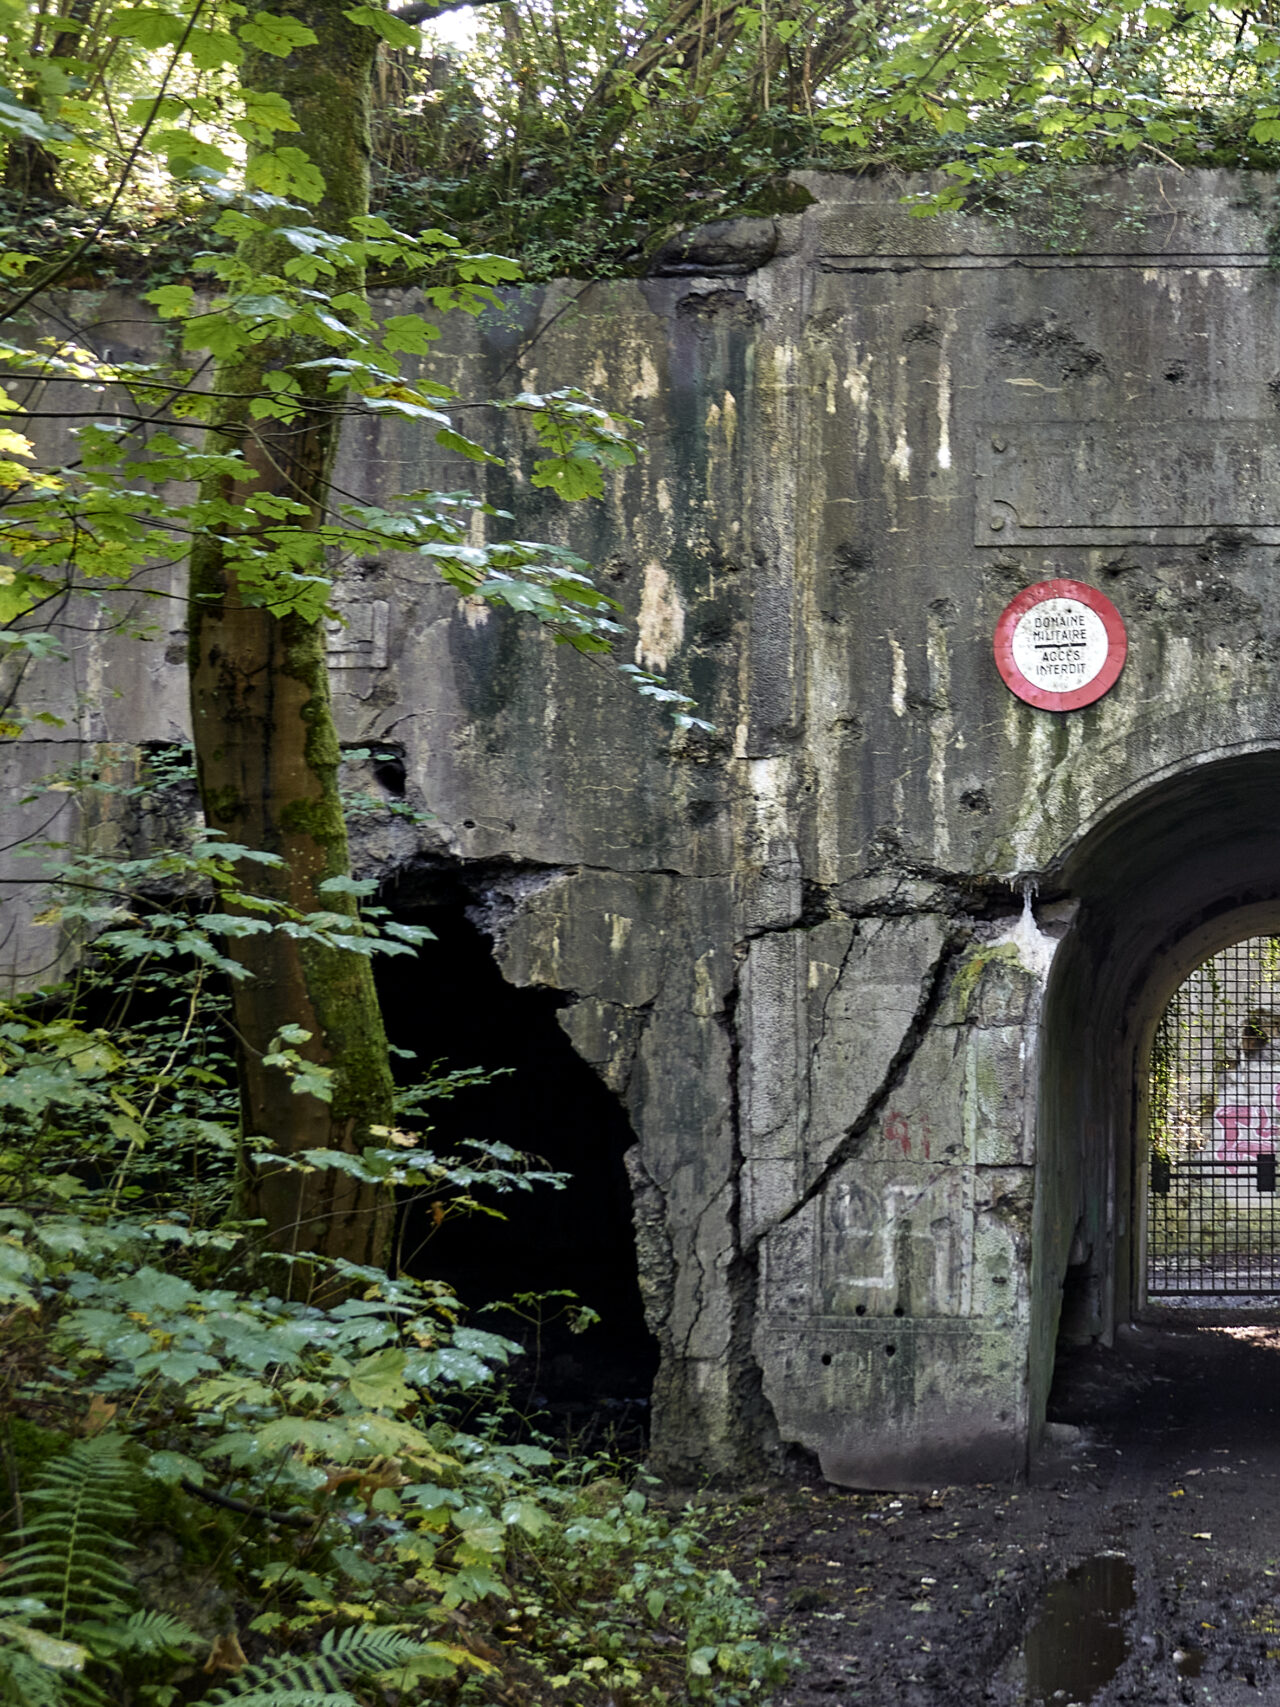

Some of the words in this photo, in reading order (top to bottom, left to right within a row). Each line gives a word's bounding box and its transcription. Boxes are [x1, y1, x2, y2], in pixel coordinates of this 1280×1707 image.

[1034, 615, 1085, 628] DOMAINE
[1033, 629, 1087, 642] MILITAIRE
[1036, 663, 1086, 676] INTERDIT
